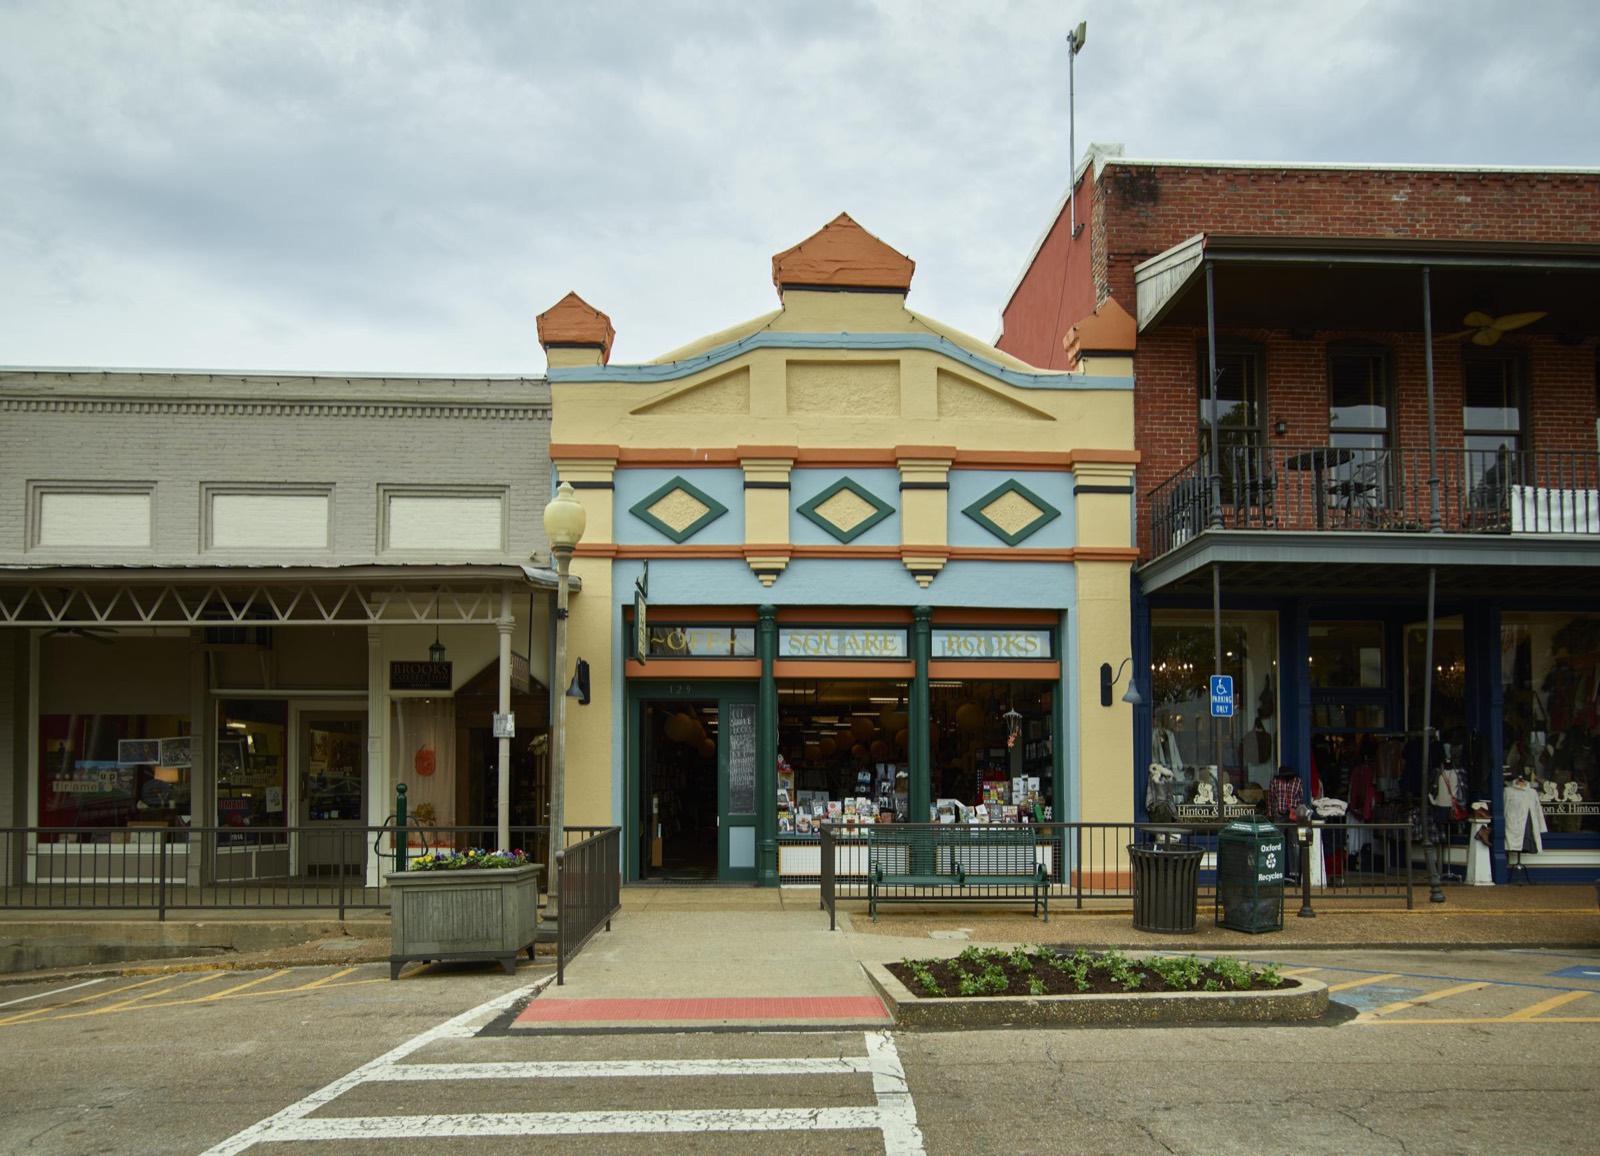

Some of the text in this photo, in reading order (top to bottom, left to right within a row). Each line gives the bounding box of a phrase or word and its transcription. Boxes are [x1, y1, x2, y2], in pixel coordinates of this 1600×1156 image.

[788, 631, 897, 654] SQUARE
[946, 632, 1038, 653] BOOKS
[394, 663, 448, 673] BROOKS
[669, 684, 691, 695] 129
[1212, 695, 1232, 704] PARKING
[1216, 705, 1229, 714] ONLY
[100, 773, 115, 781] up
[55, 782, 98, 791] frame
[219, 799, 249, 809] OMAHA
[1556, 803, 1566, 814] &
[1568, 803, 1600, 814] Hinton
[1177, 805, 1255, 816] Hinton & Hinton
[1260, 843, 1282, 853] Oxford
[1258, 871, 1283, 882] Recycles
